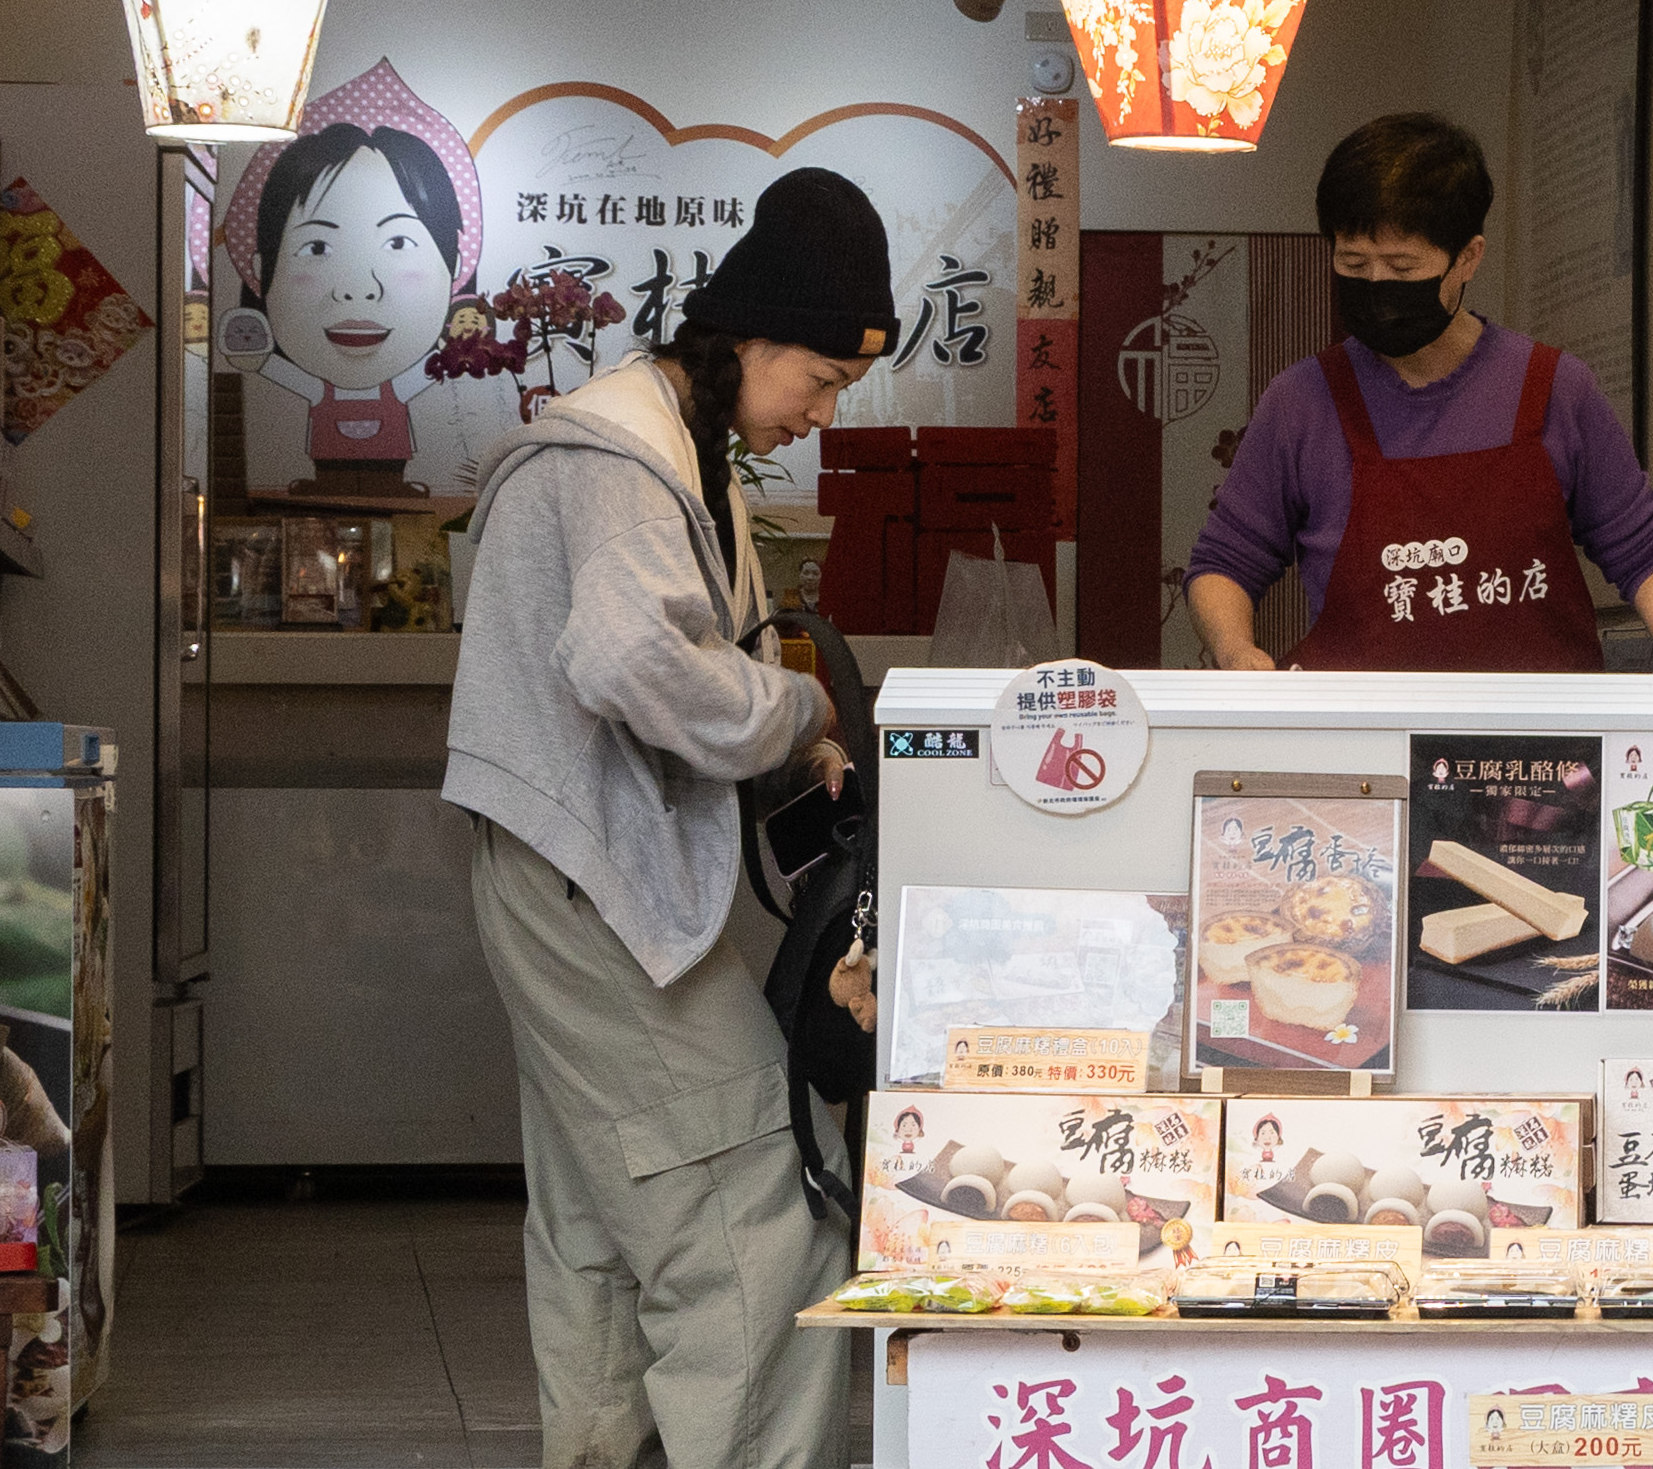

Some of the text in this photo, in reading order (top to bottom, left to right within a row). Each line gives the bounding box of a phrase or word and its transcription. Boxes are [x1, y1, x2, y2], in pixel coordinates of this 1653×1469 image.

[516, 191, 745, 228] 深坑在地原味
[1385, 540, 1464, 568] 深坑廟口
[1384, 558, 1549, 621] 寶桂的店
[1037, 668, 1096, 689] 不主動
[1017, 688, 1117, 713] 提供塑膠袋
[918, 750, 973, 758] COOL ZONE
[1454, 759, 1579, 783] 豆腐乳酪條
[881, 1158, 936, 1174] 寶桂的店
